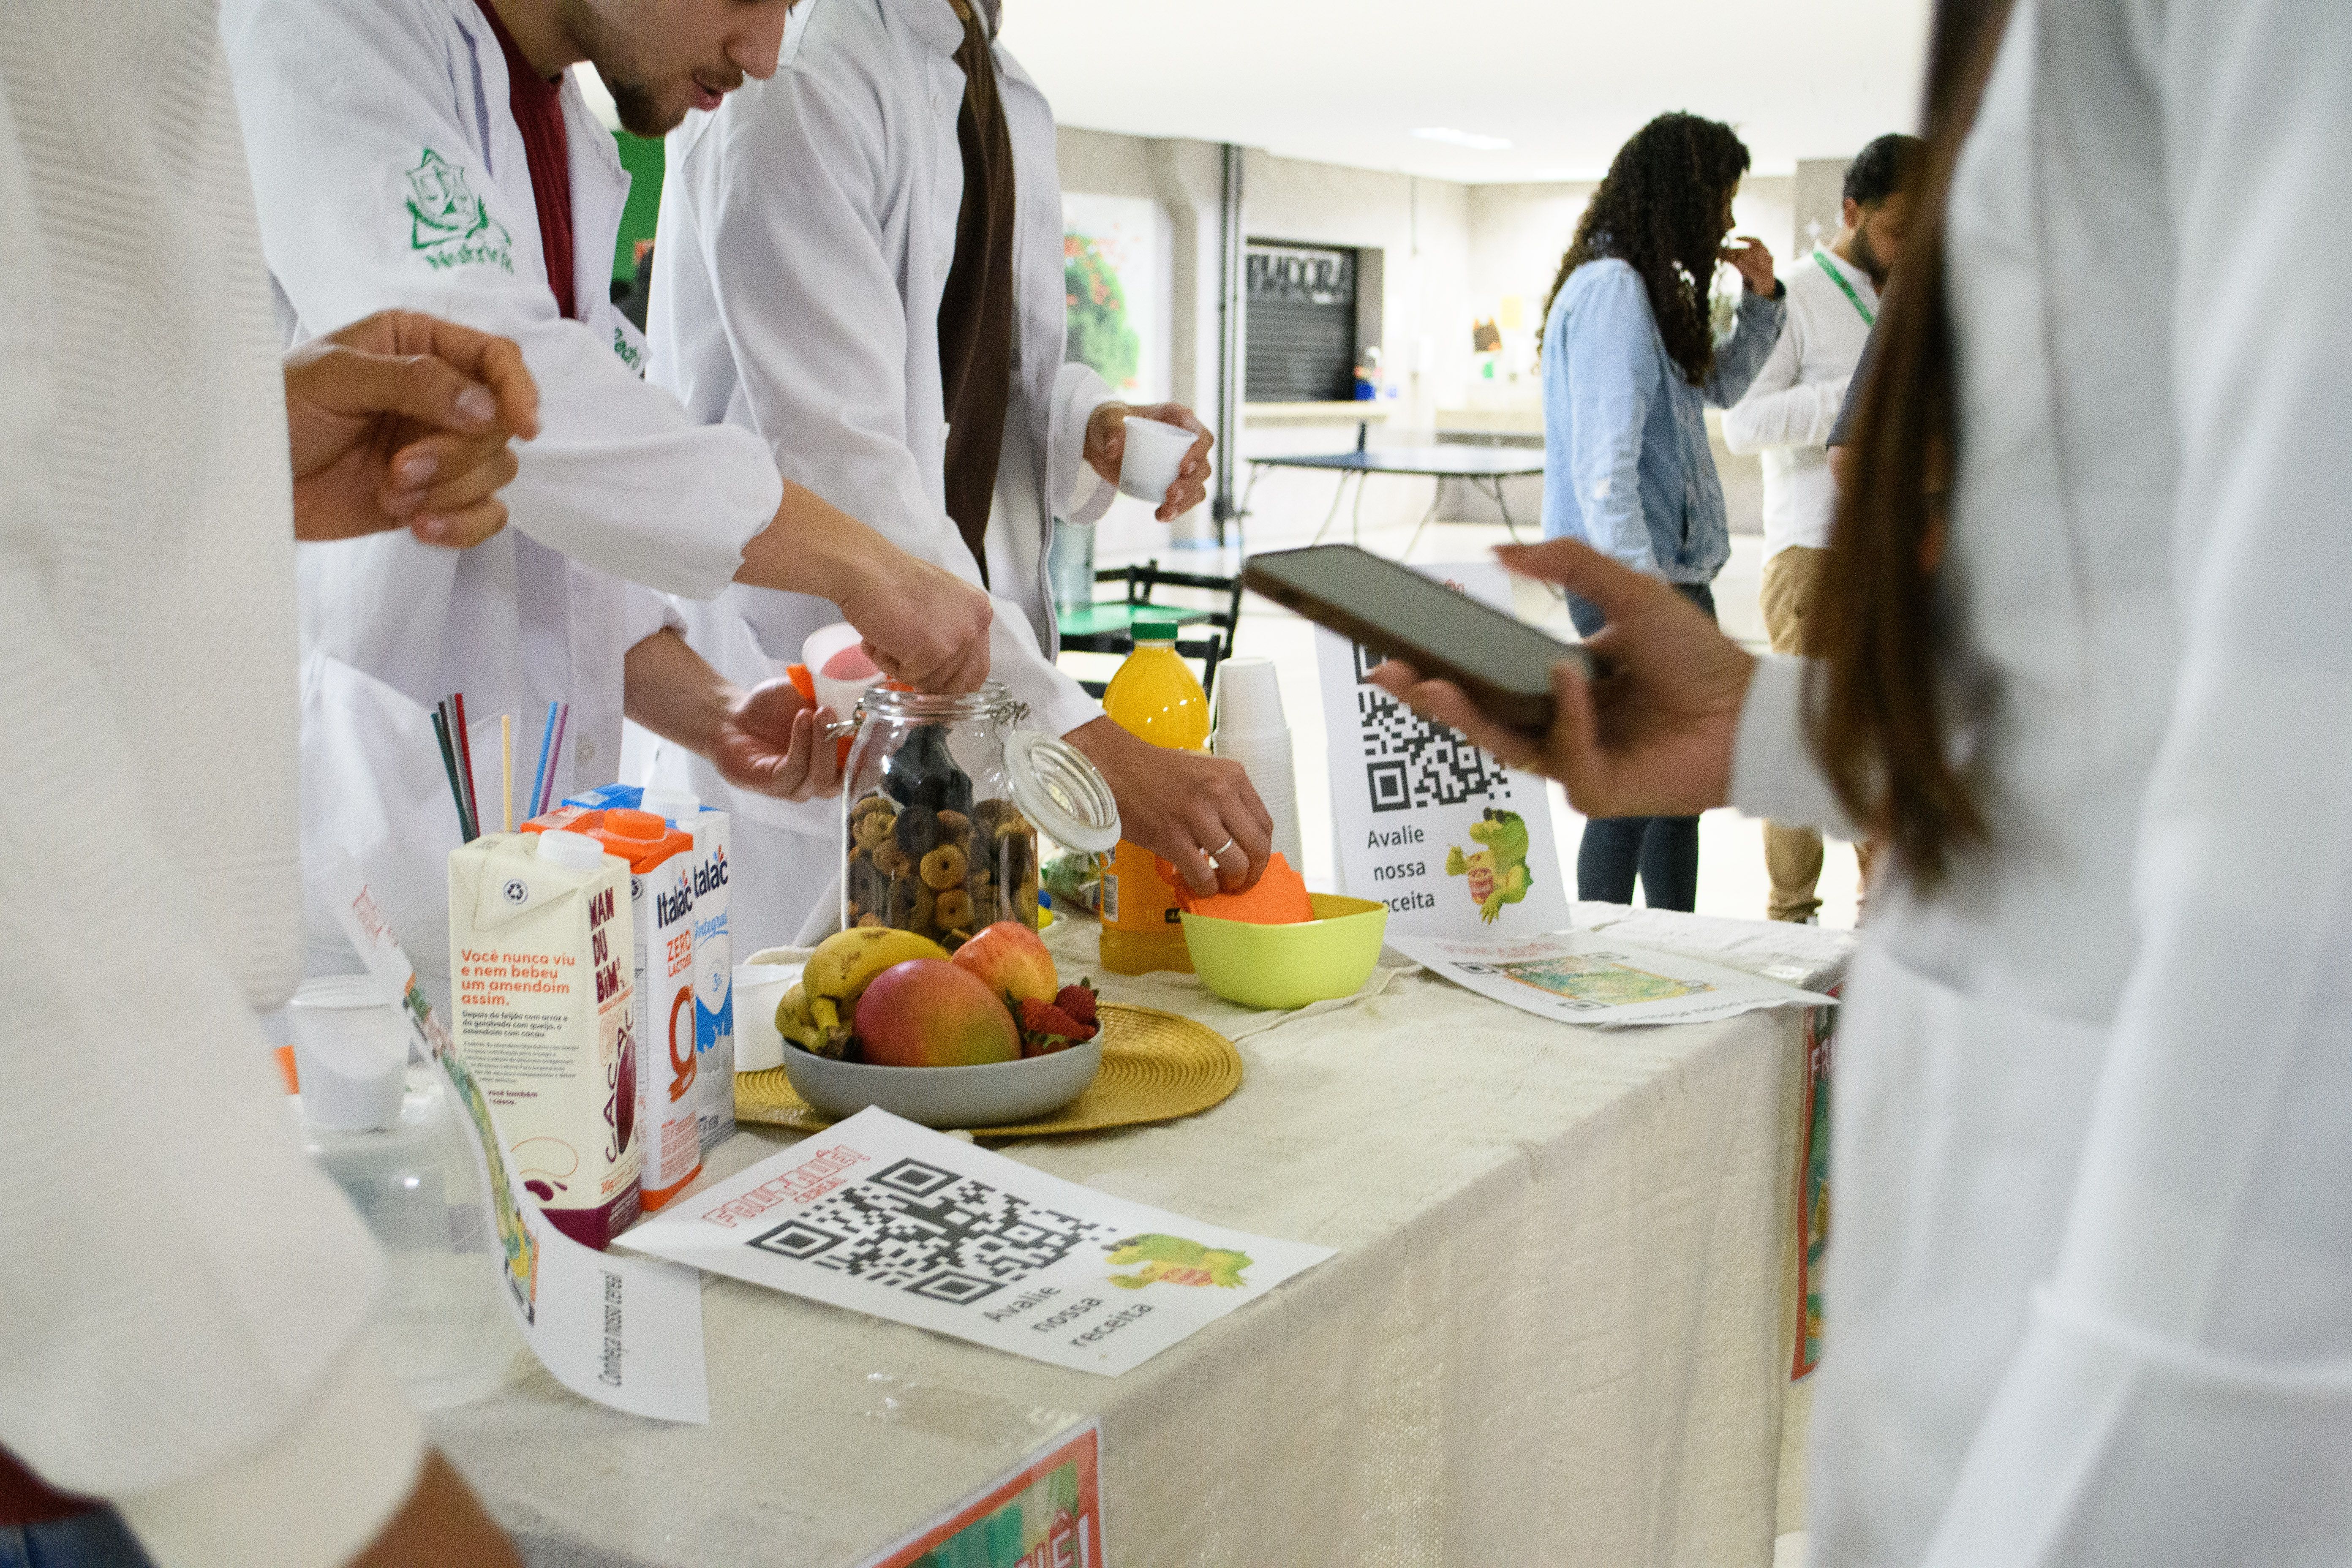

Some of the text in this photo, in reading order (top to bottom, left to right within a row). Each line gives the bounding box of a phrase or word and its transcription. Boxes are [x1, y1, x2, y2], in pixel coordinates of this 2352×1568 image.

[1367, 825, 1424, 849] Avalie
[693, 859, 728, 898] talac
[1374, 862, 1426, 881] nossa
[589, 886, 615, 931] MAN
[657, 885, 693, 929] Italac
[1382, 890, 1435, 913] eceita
[461, 949, 575, 966] Você nunca viu
[592, 928, 608, 967] DU
[667, 929, 691, 963] ZERO
[461, 964, 558, 980] e nem bebeu
[461, 980, 569, 994] um amendoim
[461, 991, 509, 1005] assim.
[463, 1010, 487, 1019] Depois
[501, 1012, 523, 1020] feijão
[506, 1088, 537, 1097] também
[603, 1003, 634, 1163] CACAU
[982, 1287, 1061, 1323] Avalie
[1031, 1297, 1103, 1333] nossa
[1069, 1303, 1154, 1348] receita
